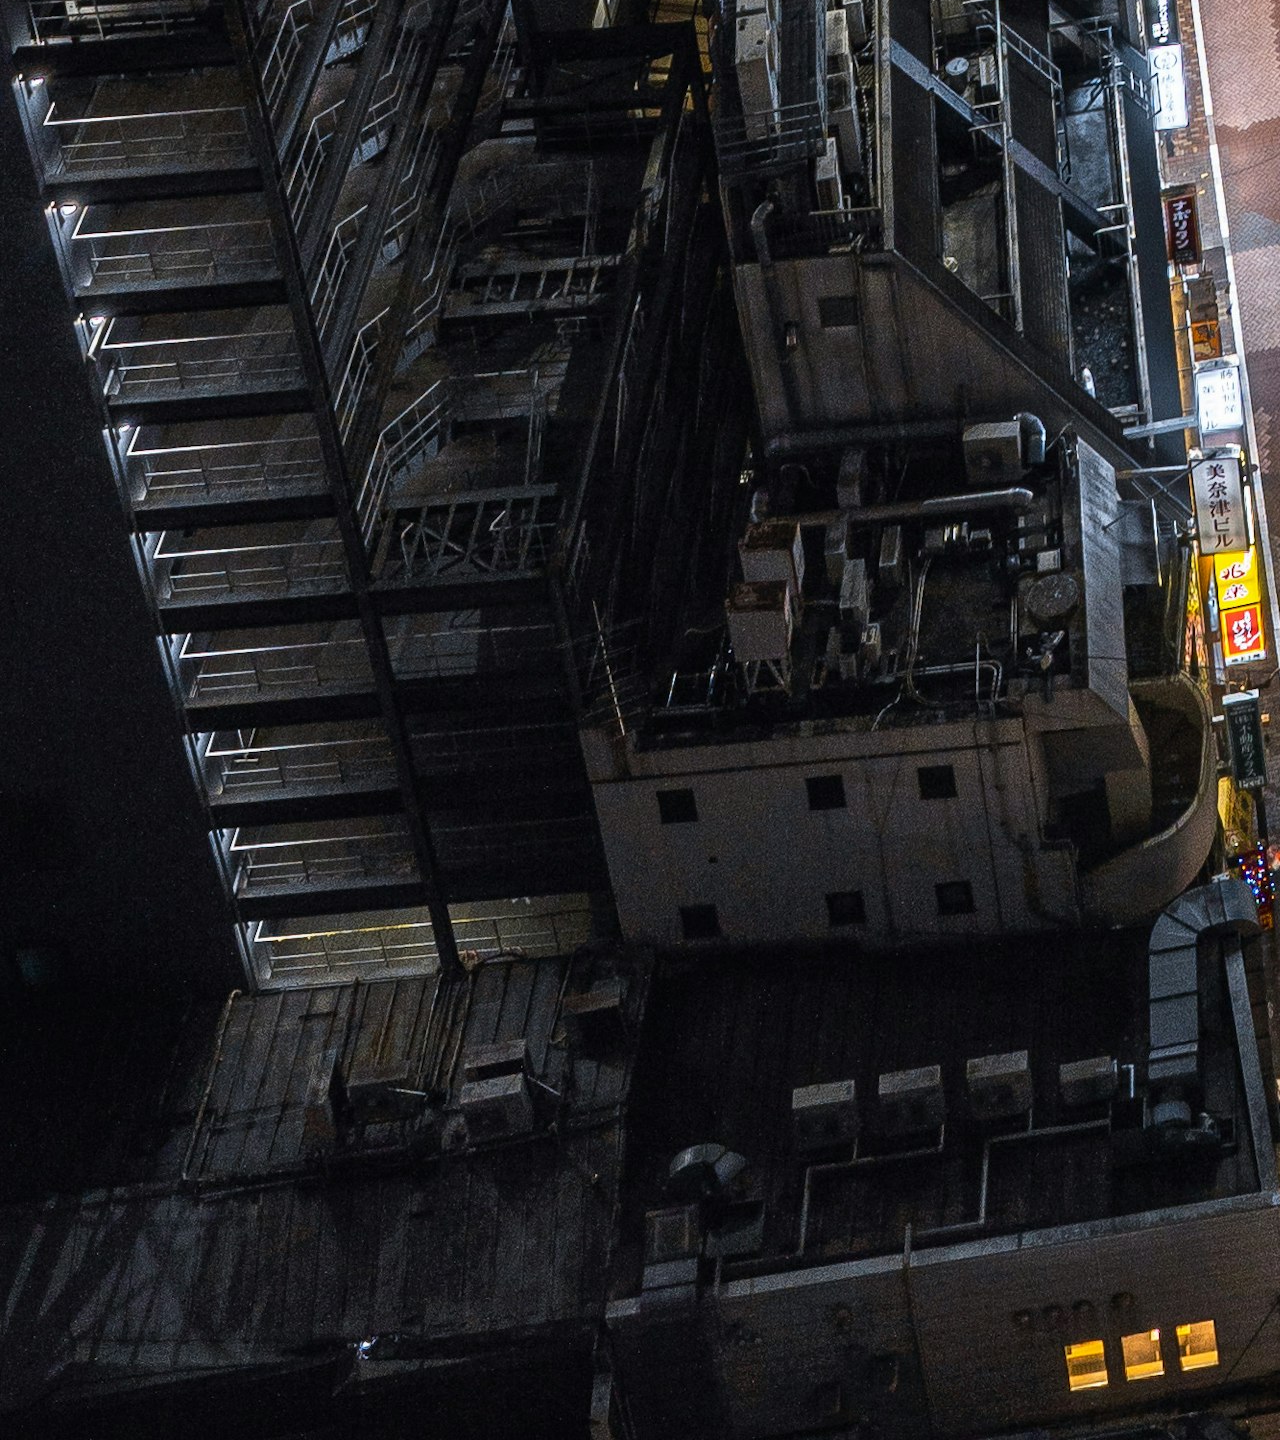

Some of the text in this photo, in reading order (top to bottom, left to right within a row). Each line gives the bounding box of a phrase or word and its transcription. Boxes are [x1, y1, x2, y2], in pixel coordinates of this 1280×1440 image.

[1173, 201, 1192, 250] ナポリタン
[1206, 463, 1233, 549] 美奈津ビル
